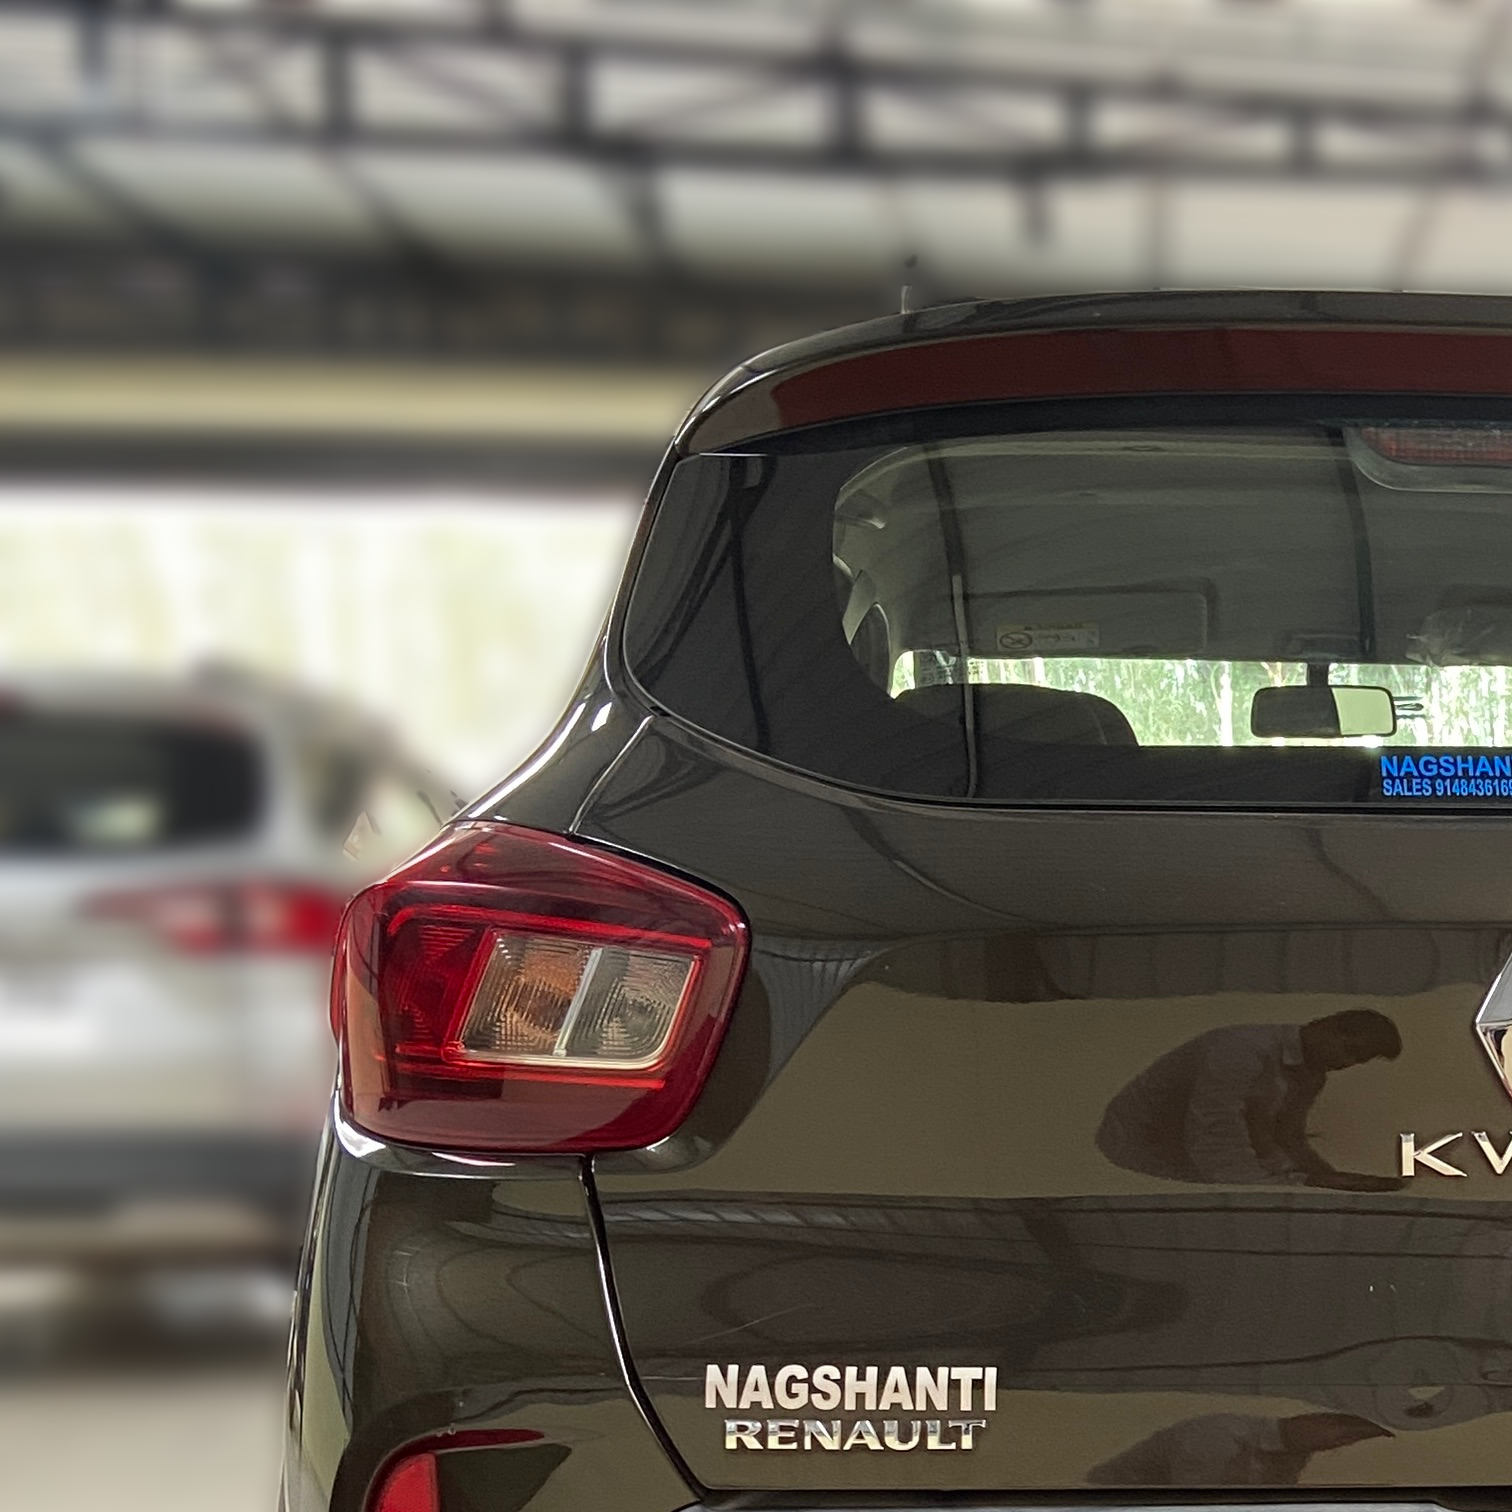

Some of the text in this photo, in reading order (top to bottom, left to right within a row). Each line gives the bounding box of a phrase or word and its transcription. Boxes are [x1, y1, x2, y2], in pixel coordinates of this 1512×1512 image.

[1383, 779, 1432, 796] SALES
[704, 1364, 998, 1411] NAGSHANTI
[723, 1418, 987, 1451] RENAULT
